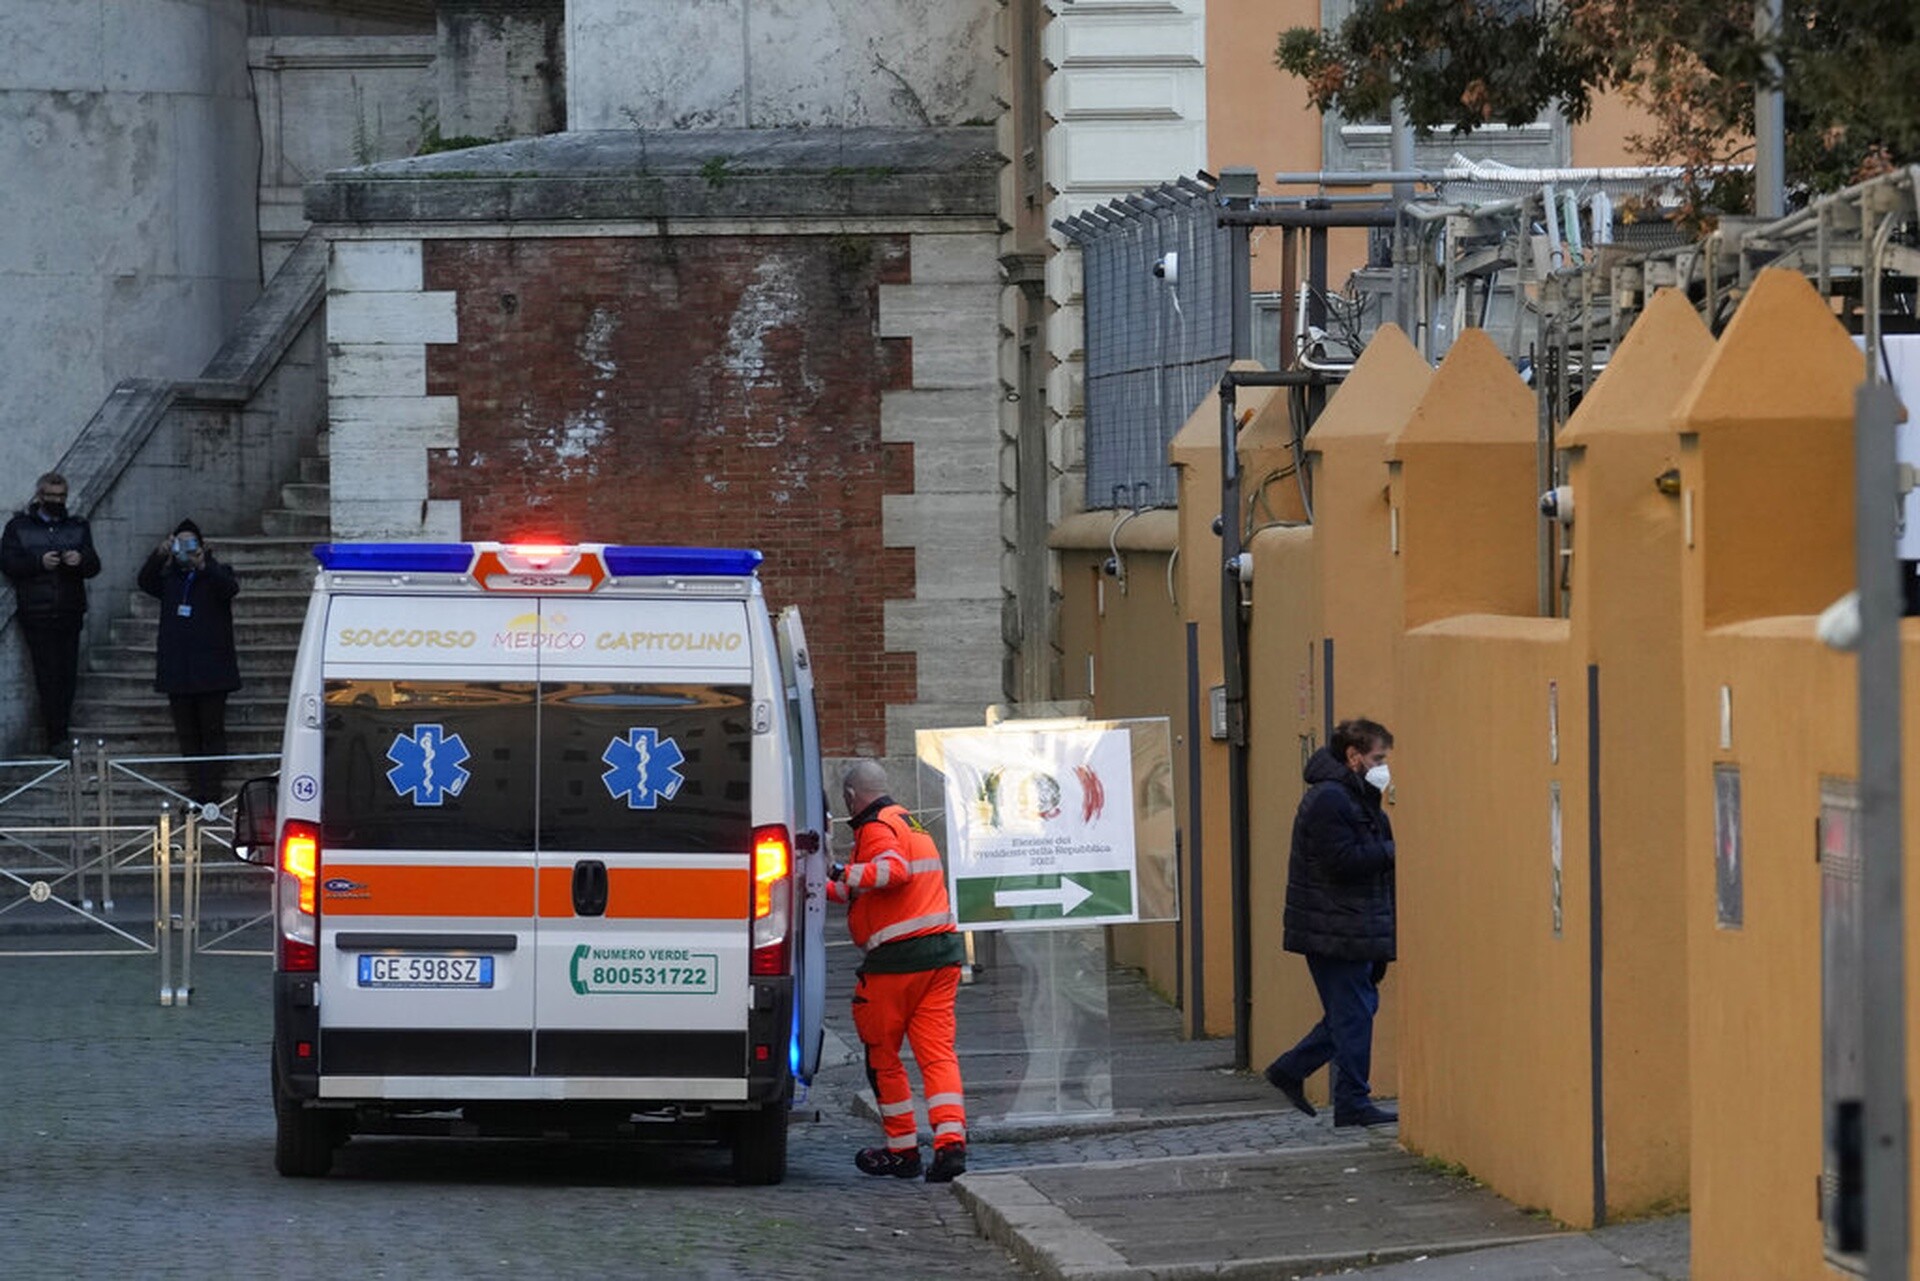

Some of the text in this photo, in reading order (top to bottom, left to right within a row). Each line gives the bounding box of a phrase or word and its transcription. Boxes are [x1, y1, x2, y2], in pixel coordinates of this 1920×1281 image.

[339, 628, 742, 650] SOCCORSO MEDICO CAPITOLINO
[297, 782, 313, 795] 14
[593, 949, 689, 961] NUMERO VERDE
[374, 959, 477, 981] GE 598SZ
[593, 967, 707, 985] 800531722
